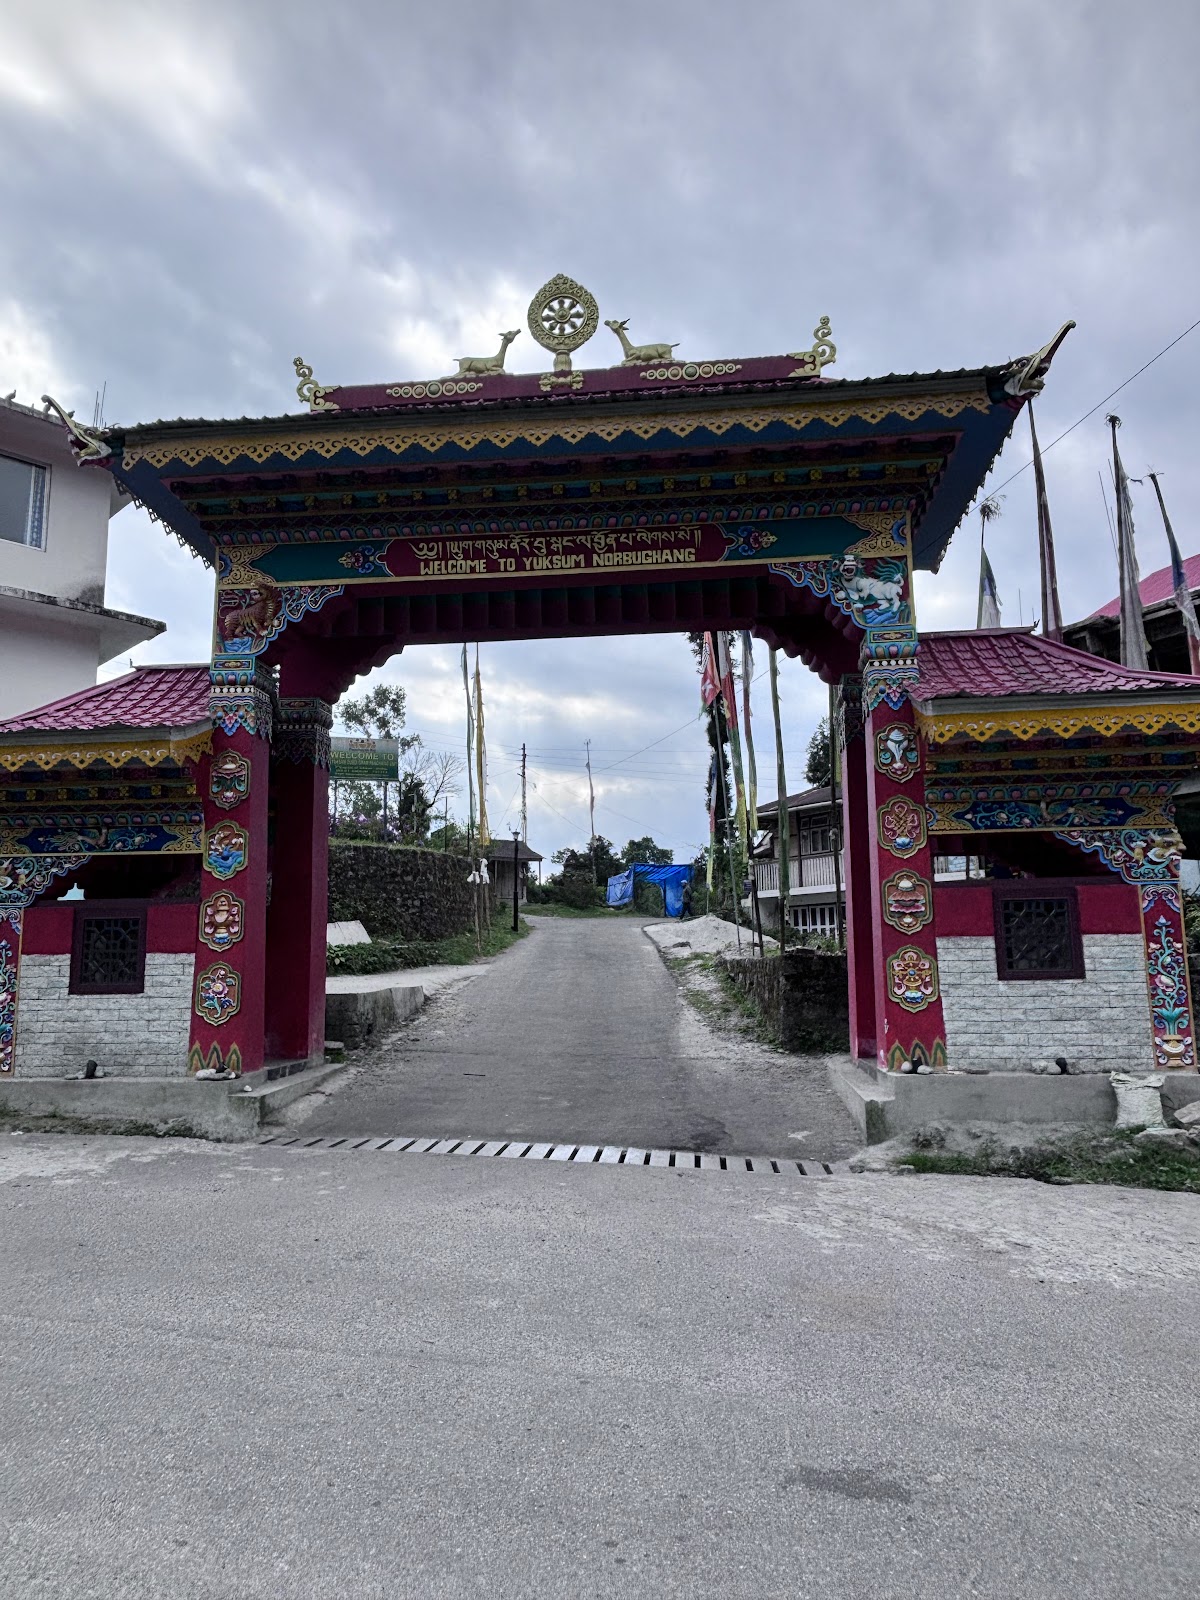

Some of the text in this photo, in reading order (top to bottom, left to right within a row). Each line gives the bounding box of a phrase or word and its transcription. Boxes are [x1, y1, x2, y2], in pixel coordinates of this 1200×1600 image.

[420, 548, 696, 575] WELCOME TO YUKSUM NORBUGHANG
[330, 751, 379, 760] WELCOME
